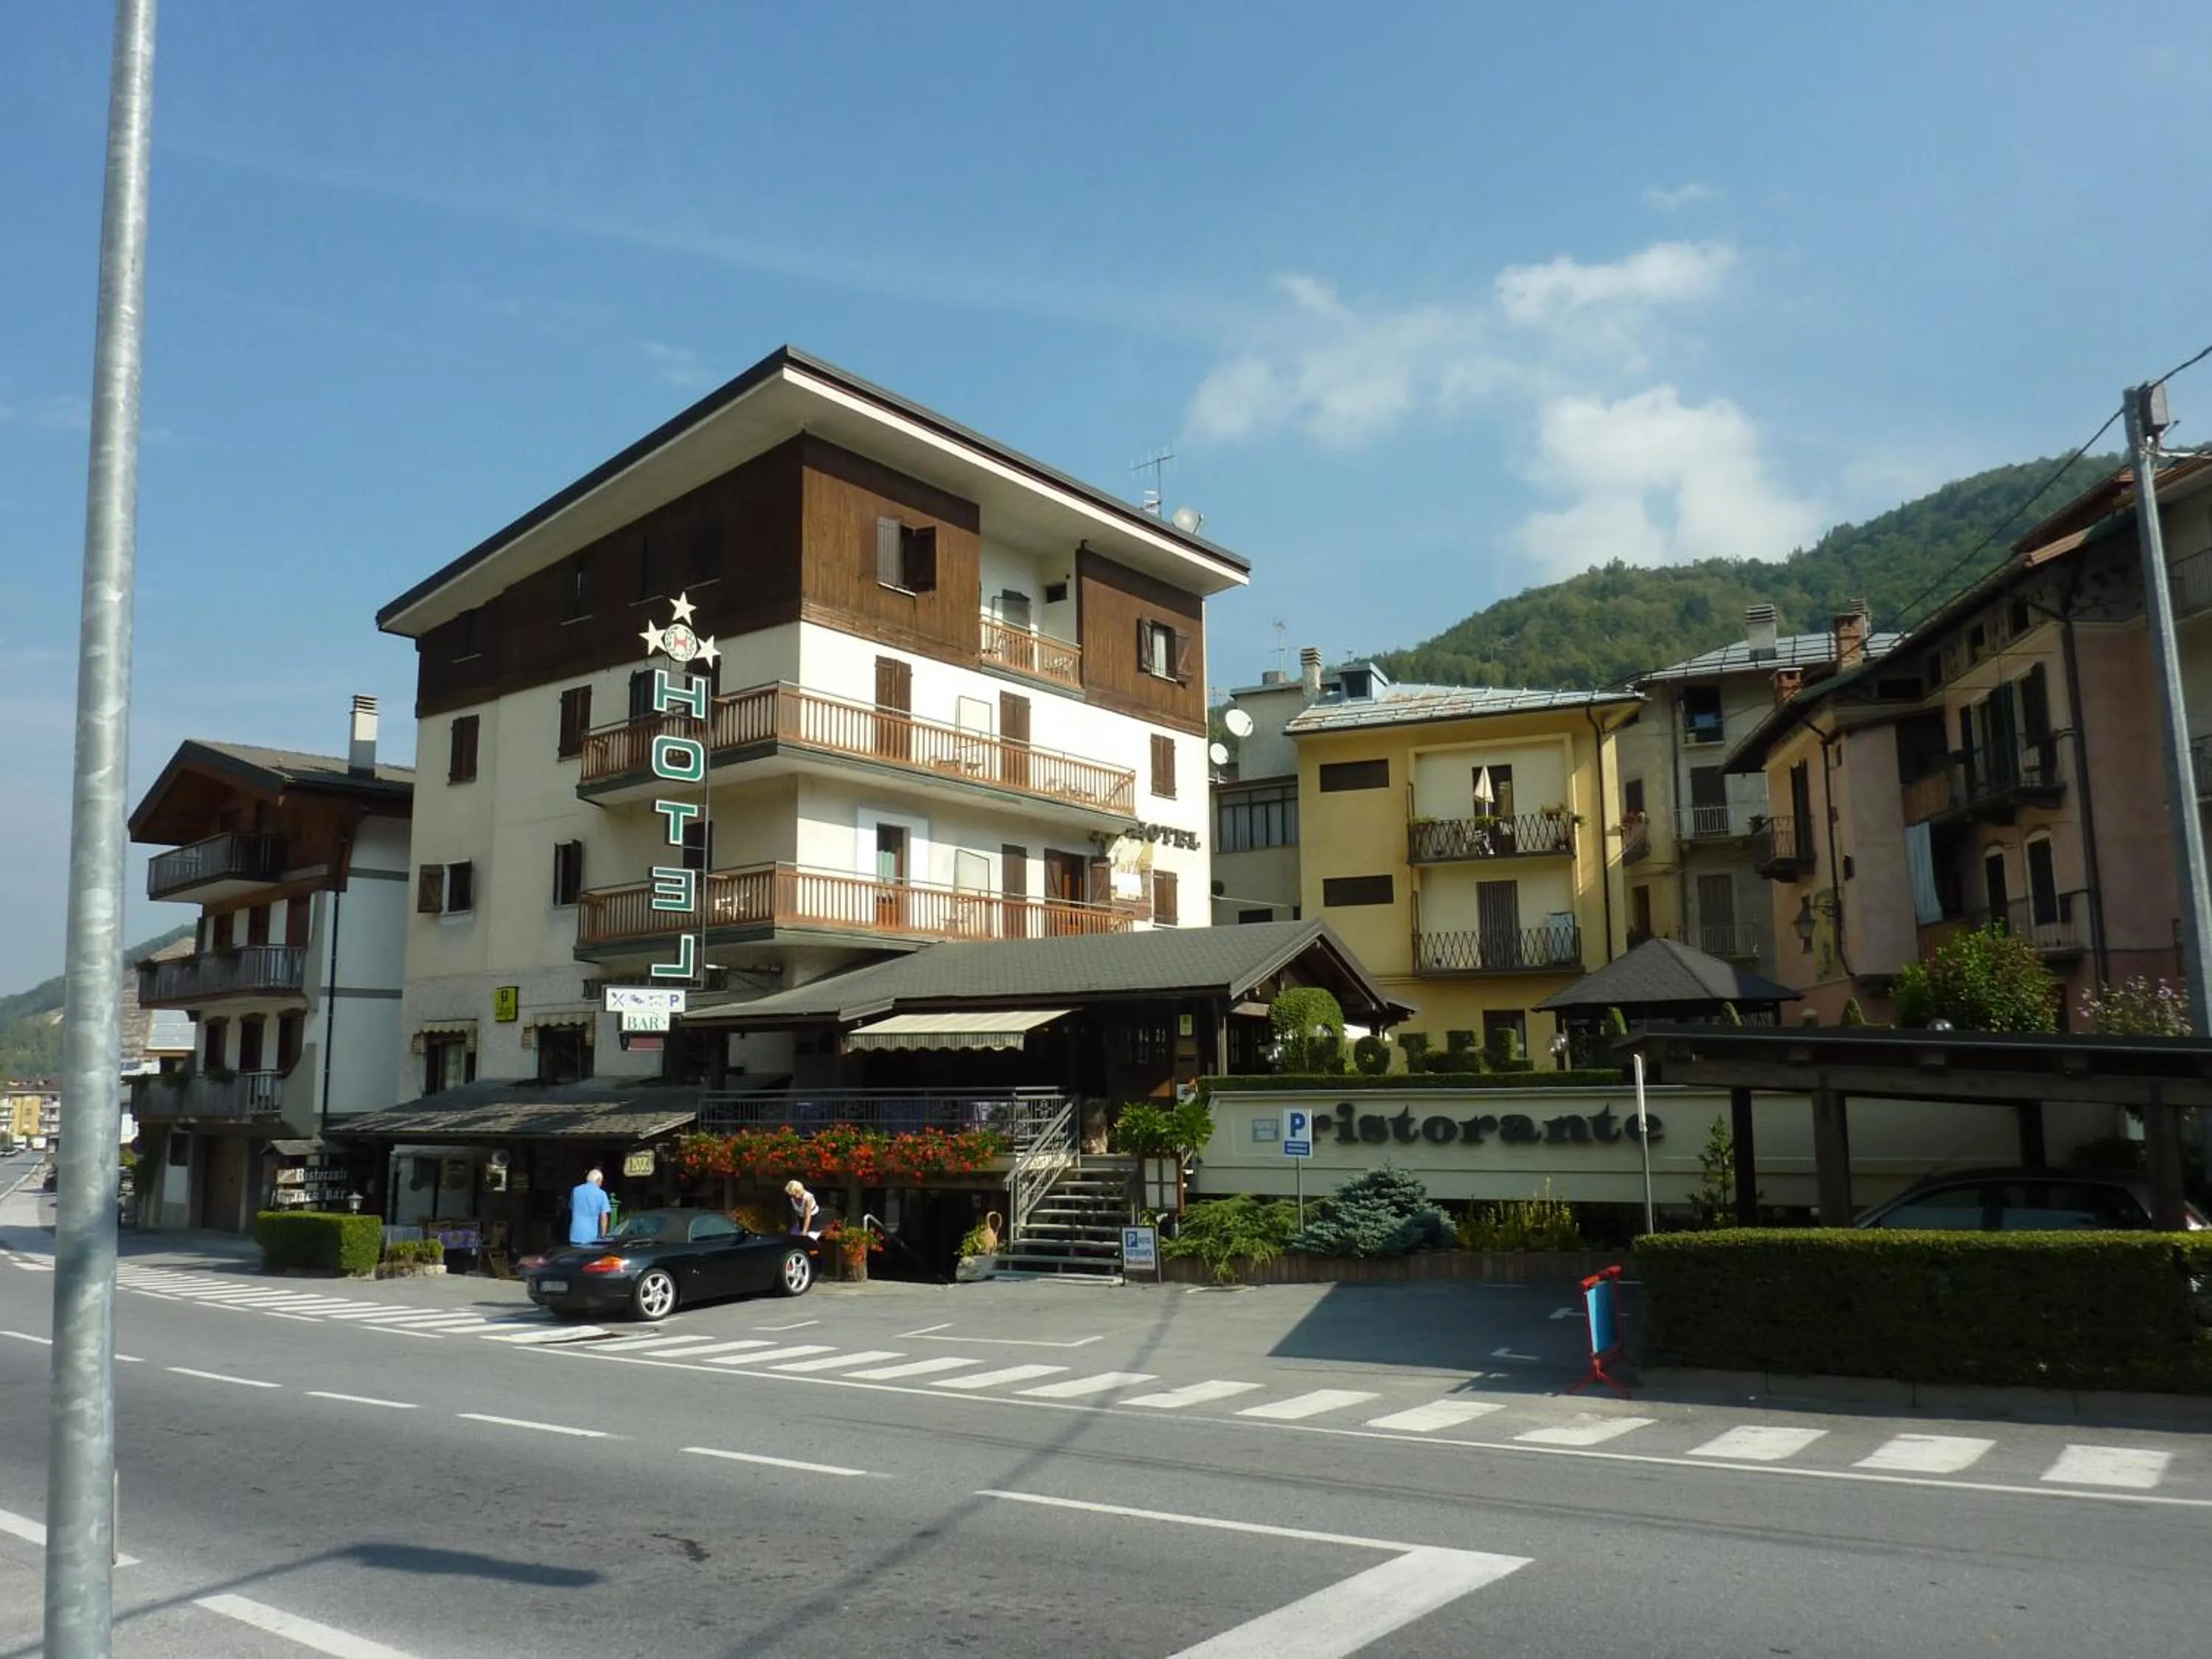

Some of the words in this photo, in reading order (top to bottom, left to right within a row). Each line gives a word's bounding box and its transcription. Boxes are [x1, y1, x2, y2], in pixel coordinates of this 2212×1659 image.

[670, 994, 680, 1007] P
[627, 1016, 659, 1029] BAR
[1290, 1113, 1306, 1138] P
[1311, 1102, 1665, 1145] ristorante
[1127, 1233, 1136, 1246] P
